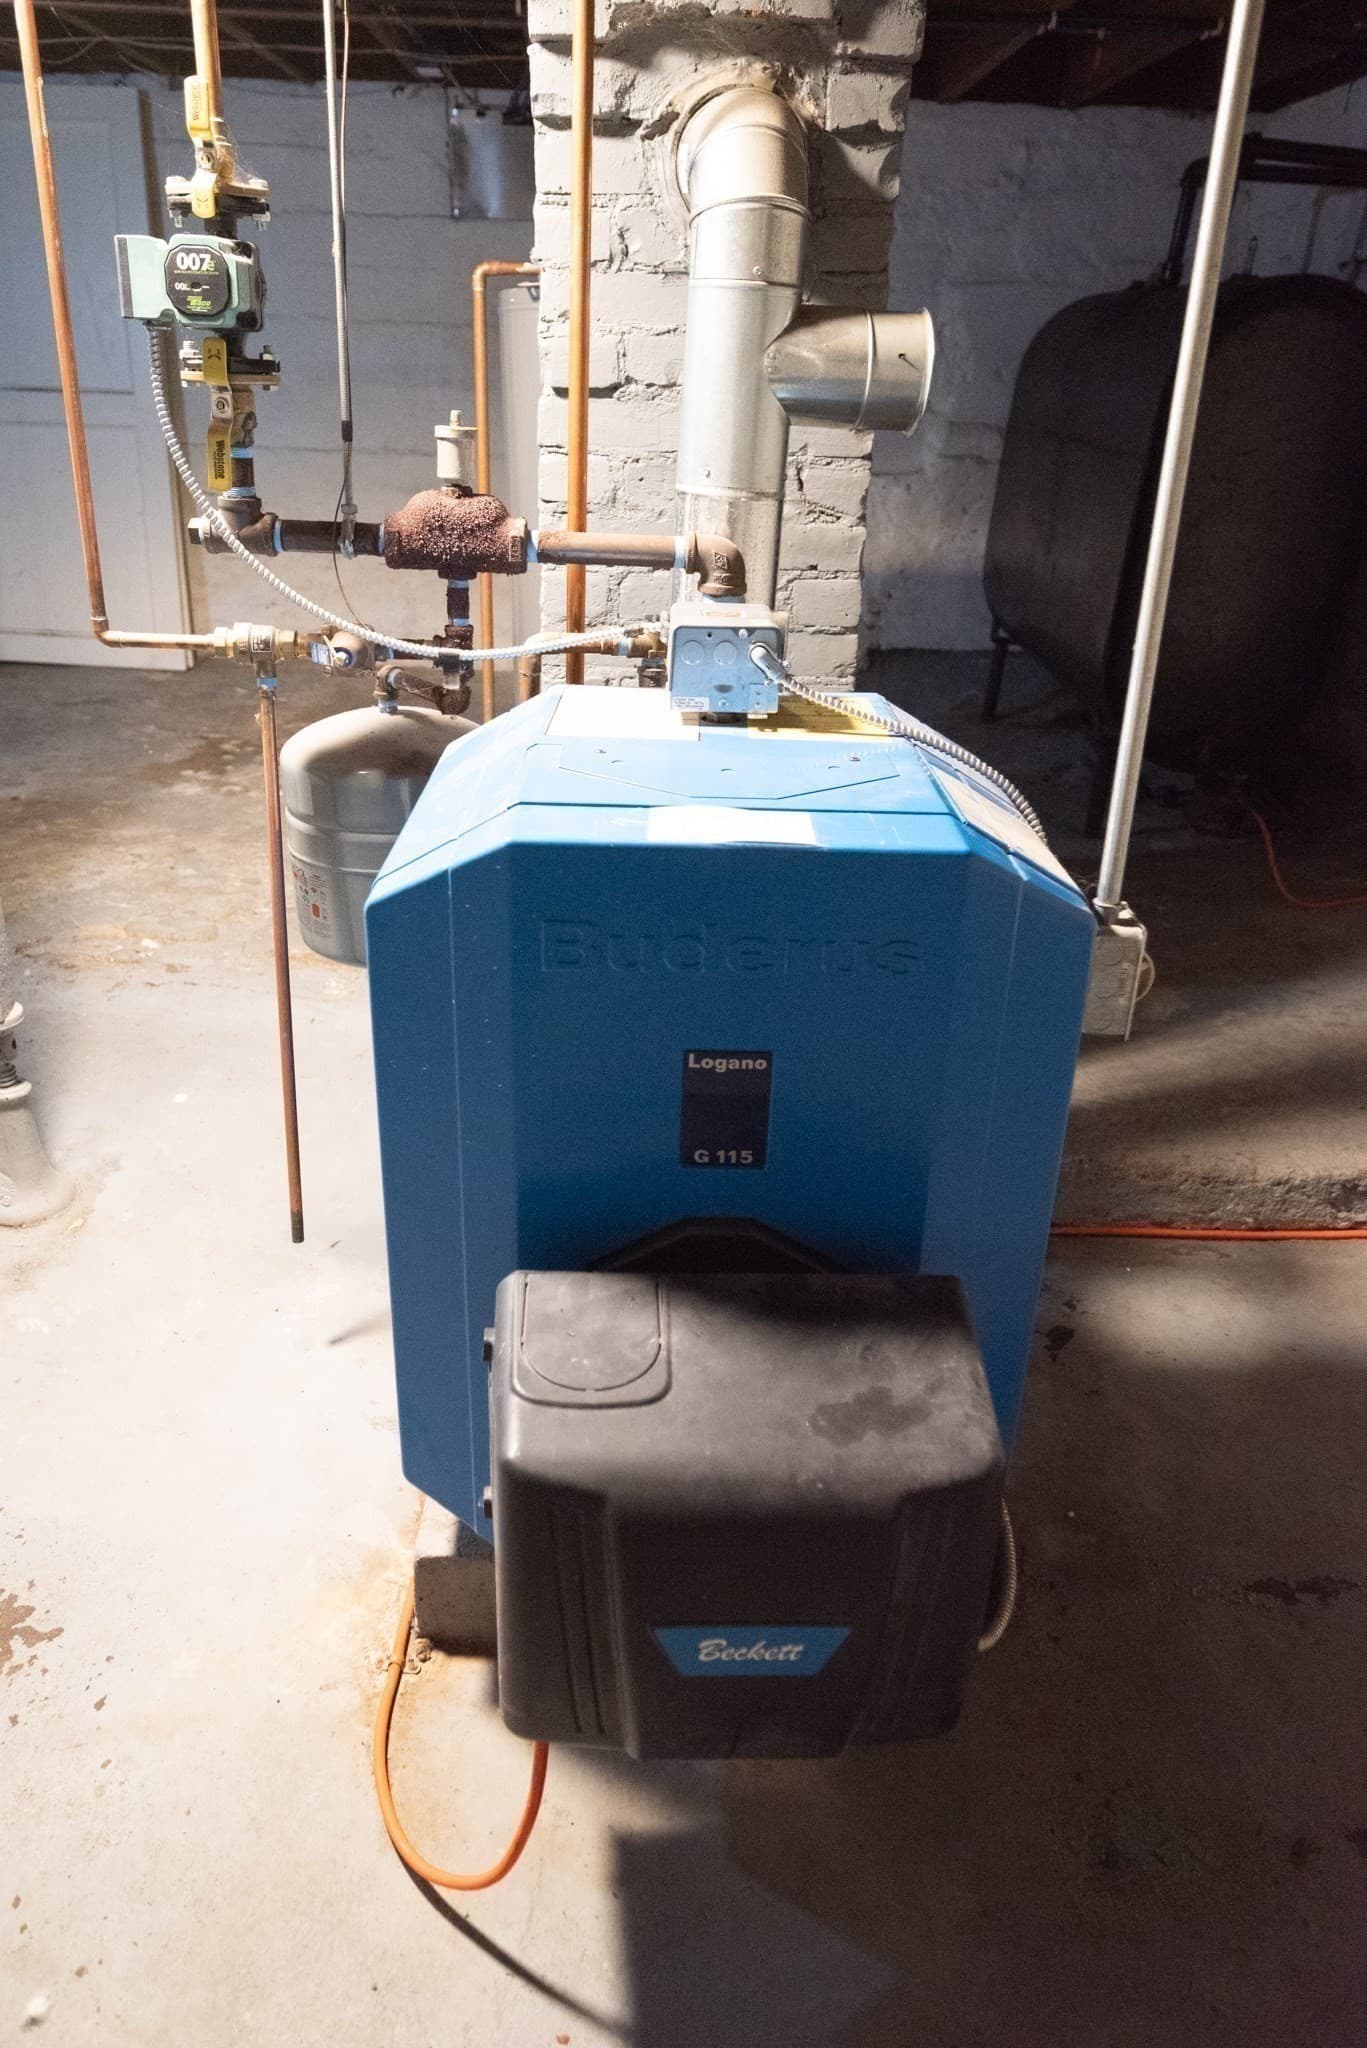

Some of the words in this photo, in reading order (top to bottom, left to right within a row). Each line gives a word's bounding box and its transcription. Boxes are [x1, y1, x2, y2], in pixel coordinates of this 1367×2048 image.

[215, 440, 225, 479] Webstone
[540, 919, 925, 974] Buderus
[688, 1053, 768, 1073] Logano
[693, 1149, 710, 1163] G
[716, 1149, 754, 1163] 115
[698, 1637, 804, 1661] Beckett
